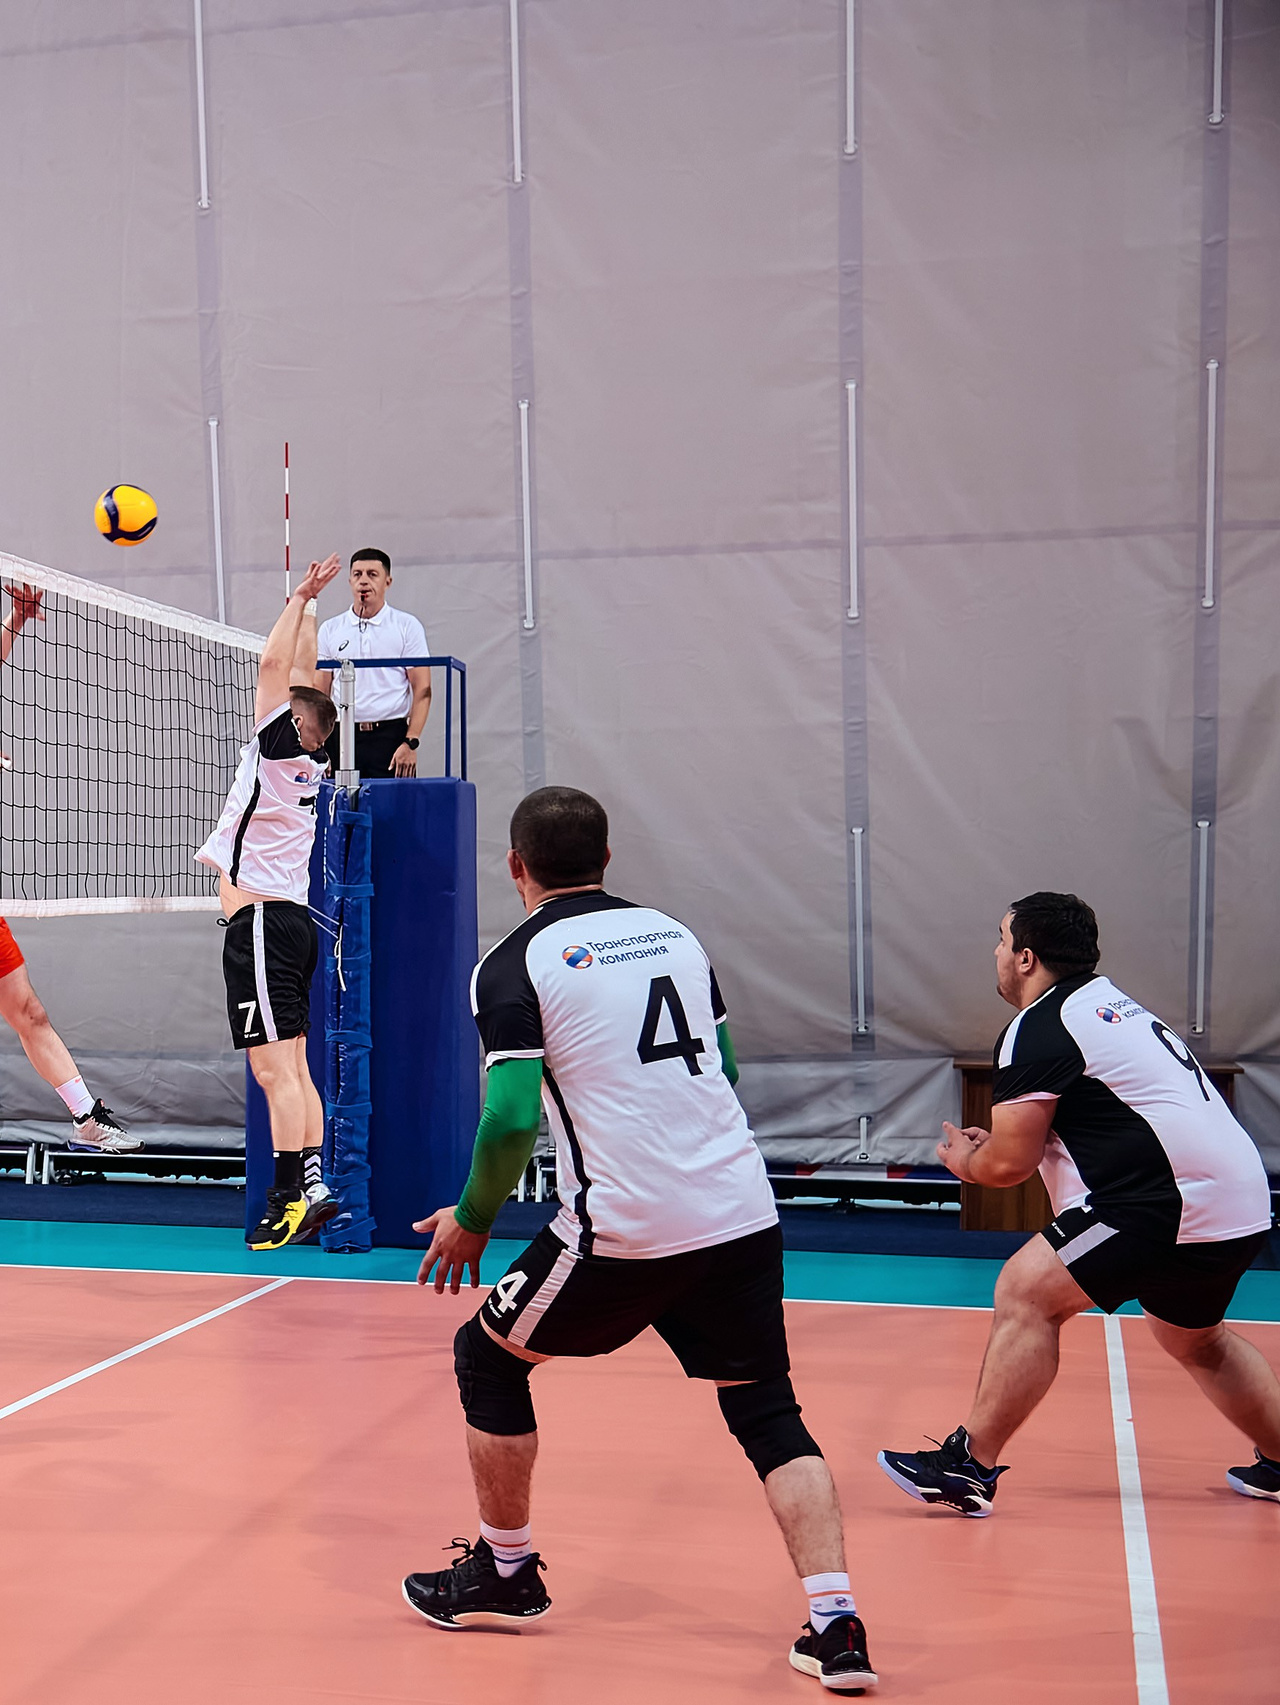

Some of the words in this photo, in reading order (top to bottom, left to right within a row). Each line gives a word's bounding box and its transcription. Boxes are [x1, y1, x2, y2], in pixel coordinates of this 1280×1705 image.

[586, 929, 685, 954] Транспортная
[598, 945, 670, 966] компания
[238, 1000, 257, 1034] 7
[636, 975, 706, 1077] 4
[1151, 1020, 1211, 1102] 9
[496, 1270, 529, 1314] 4
